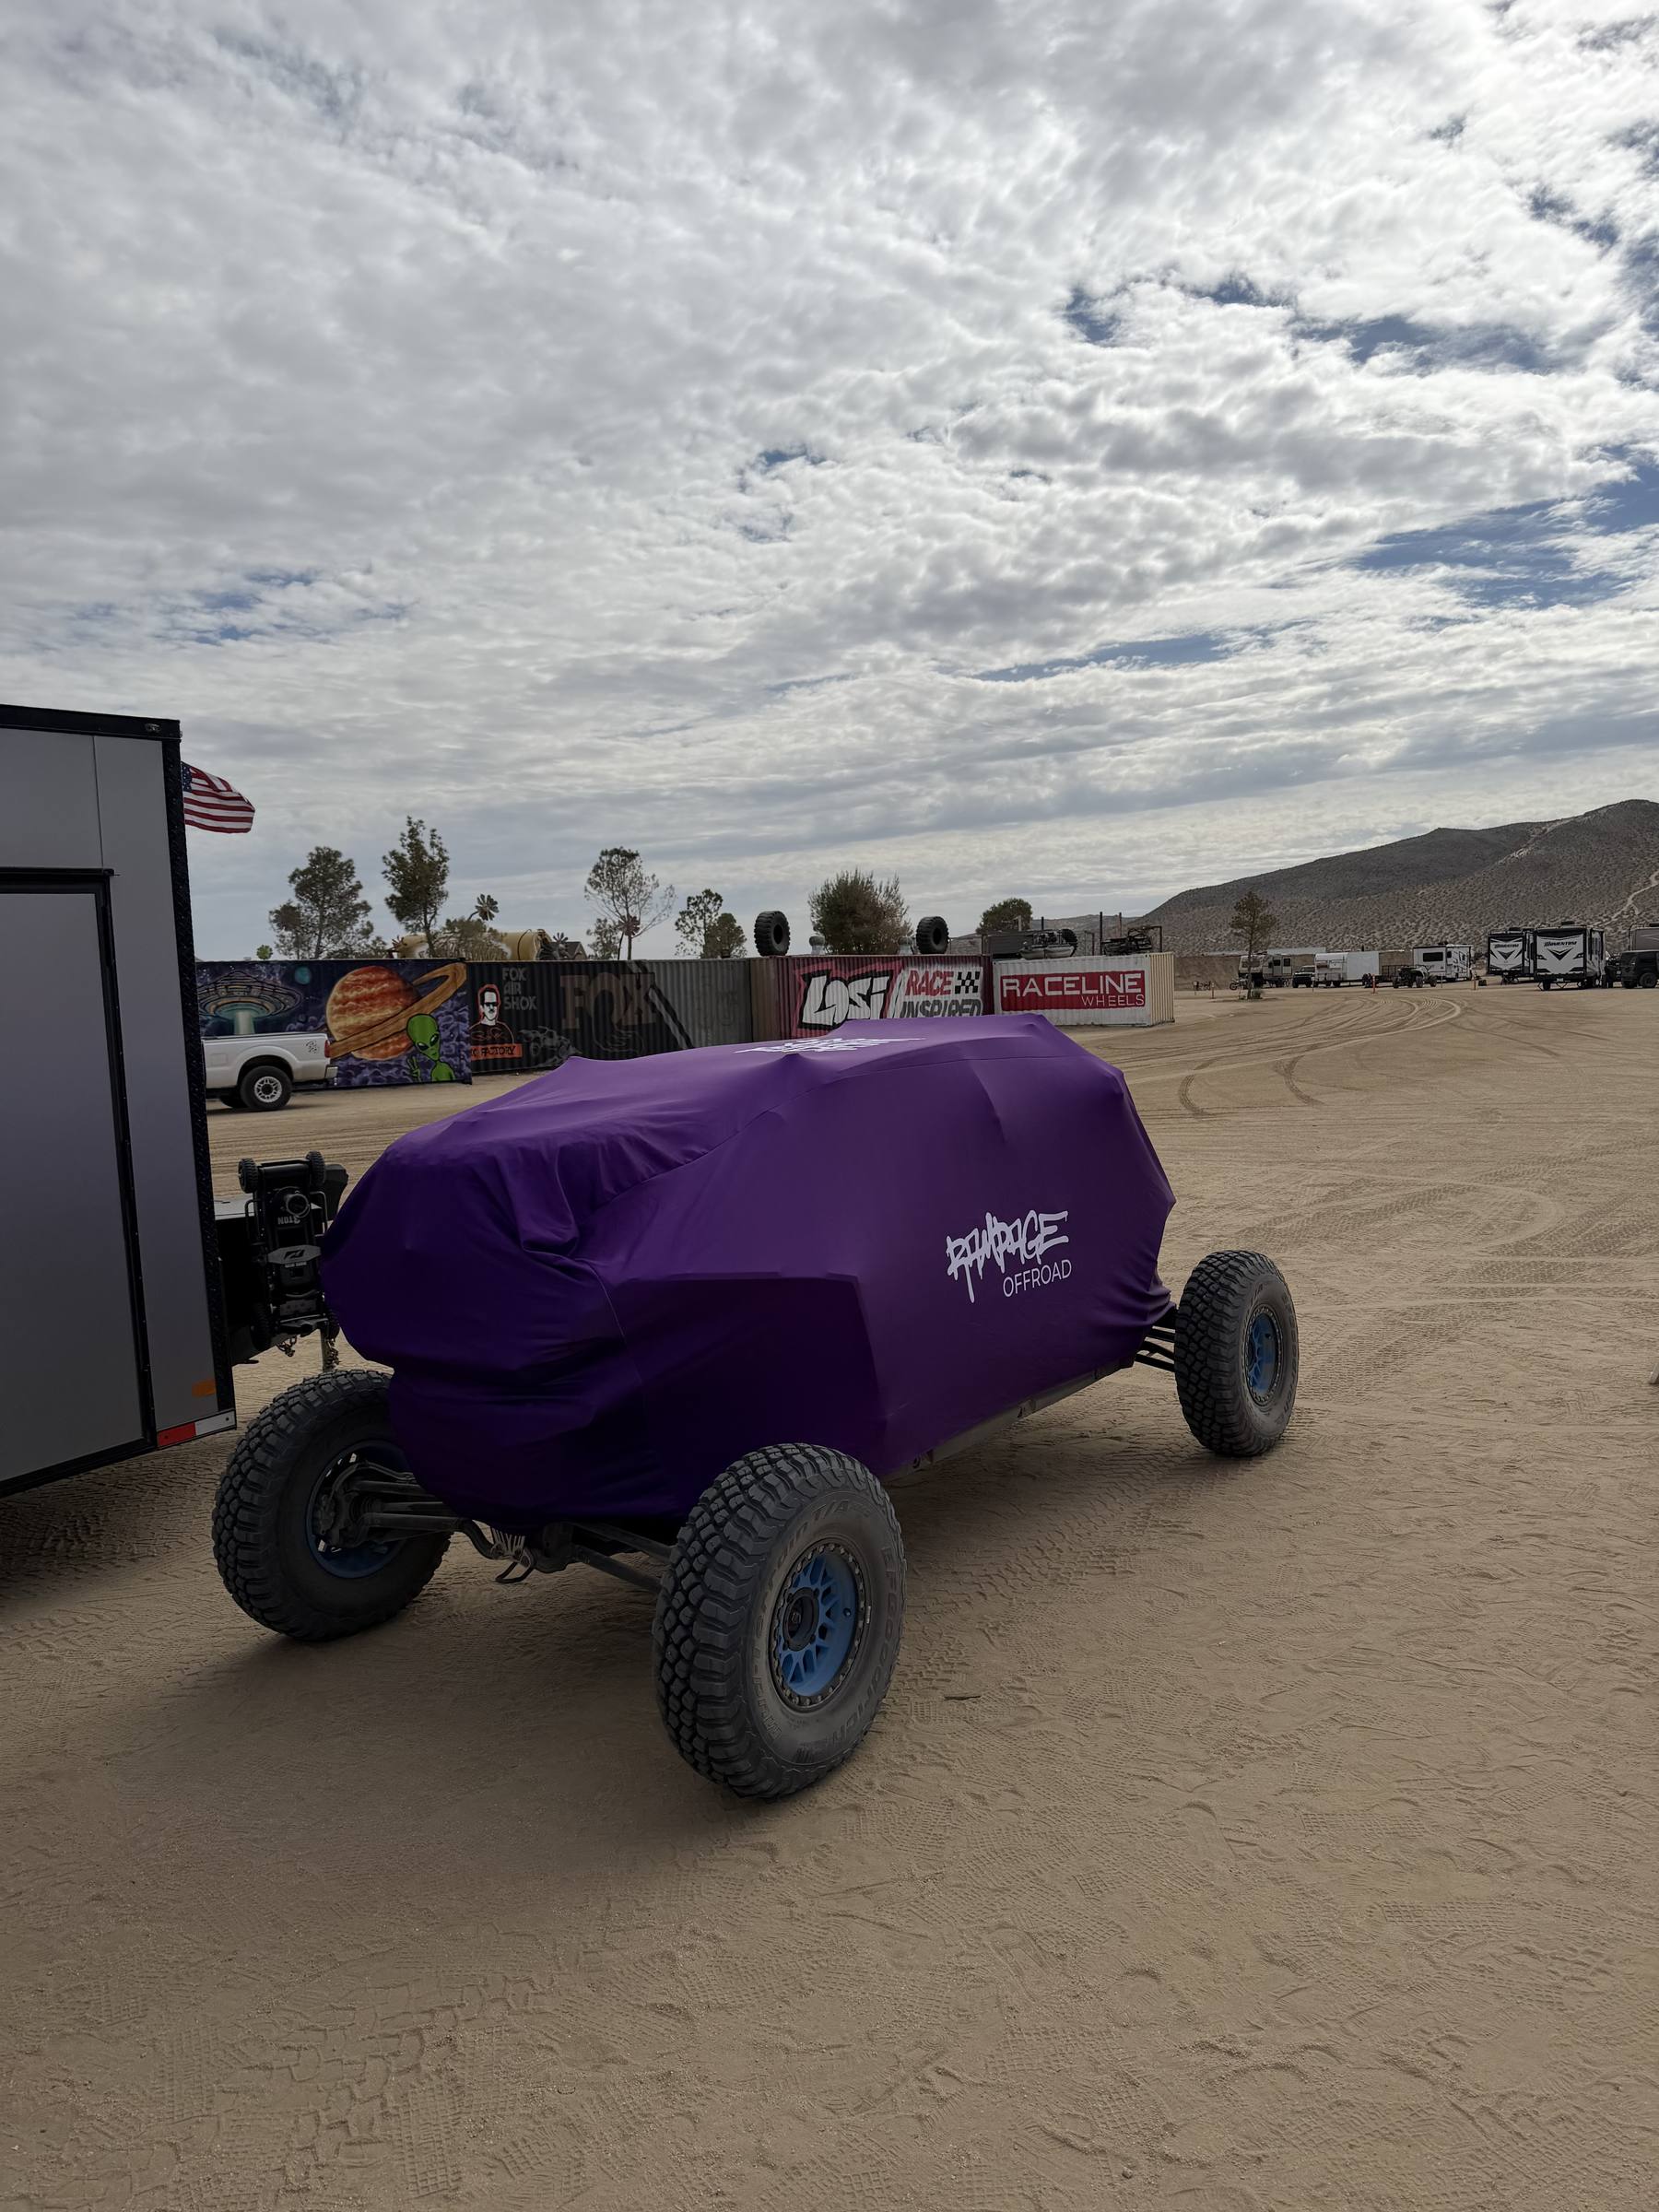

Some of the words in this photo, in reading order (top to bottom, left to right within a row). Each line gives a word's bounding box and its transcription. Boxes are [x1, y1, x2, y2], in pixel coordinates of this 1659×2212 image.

[501, 967, 530, 982] FOX
[904, 970, 954, 996] RACE
[1002, 972, 1142, 998] RACELINE
[503, 982, 522, 995] AIR
[503, 995, 538, 1010] SHOK
[559, 972, 656, 1030] FOX
[900, 998, 982, 1018] INSPIRED
[1080, 994, 1146, 1007] WHEELS
[946, 1208, 1070, 1303] RAMPAGE
[1002, 1259, 1073, 1298] OFFROAD
